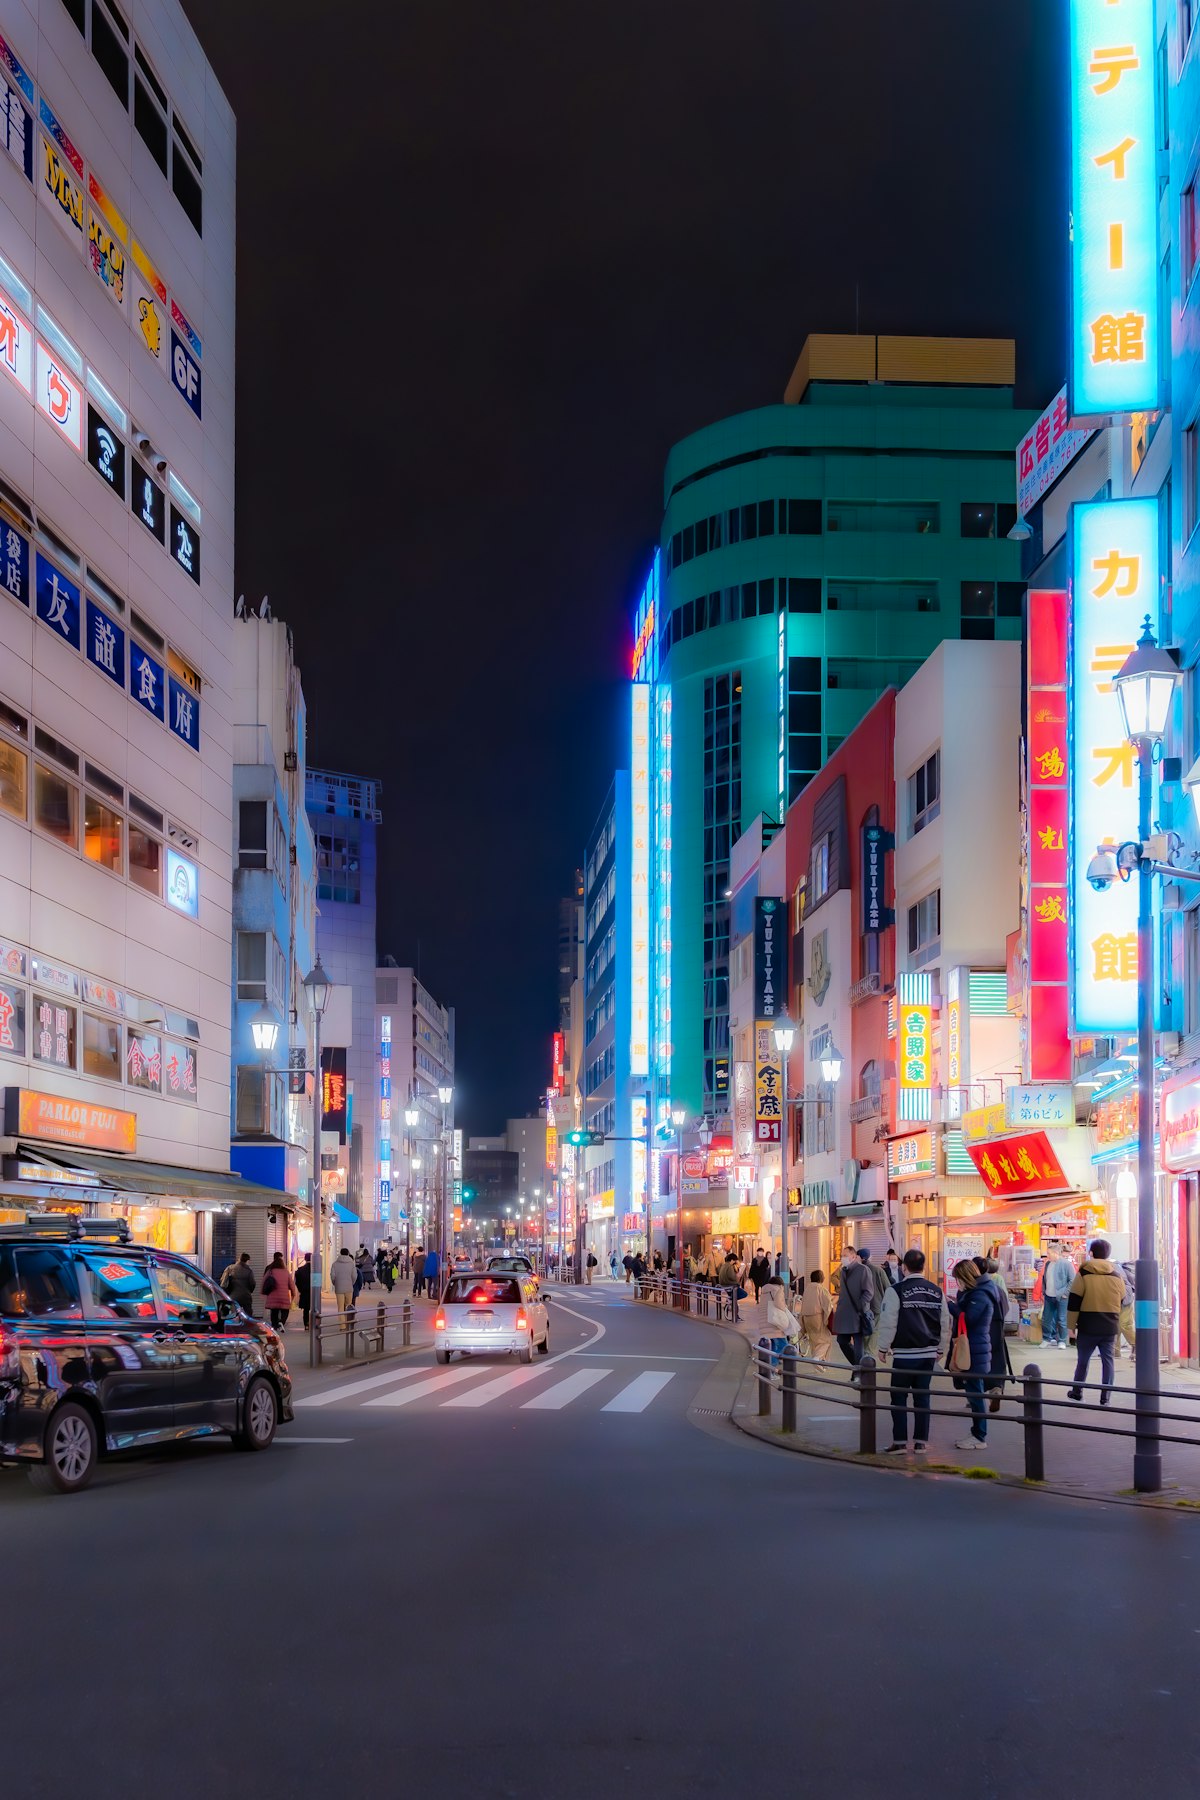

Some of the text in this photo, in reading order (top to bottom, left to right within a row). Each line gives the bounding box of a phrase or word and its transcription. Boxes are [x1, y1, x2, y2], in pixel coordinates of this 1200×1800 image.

[1089, 0, 1144, 363] ティー館
[174, 345, 198, 400] 6F
[1090, 549, 1141, 982] カラオ館
[906, 1012, 926, 1081] 吉野家
[330, 1075, 345, 1111] Wendy's
[758, 1065, 781, 1117] 金の蔵
[1021, 1093, 1058, 1105] カイダ
[39, 1099, 118, 1130] PARLOR FUJI
[758, 1123, 779, 1139] B1
[1020, 1108, 1064, 1120] 第6ビル
[946, 1238, 982, 1248] 朝食べたら
